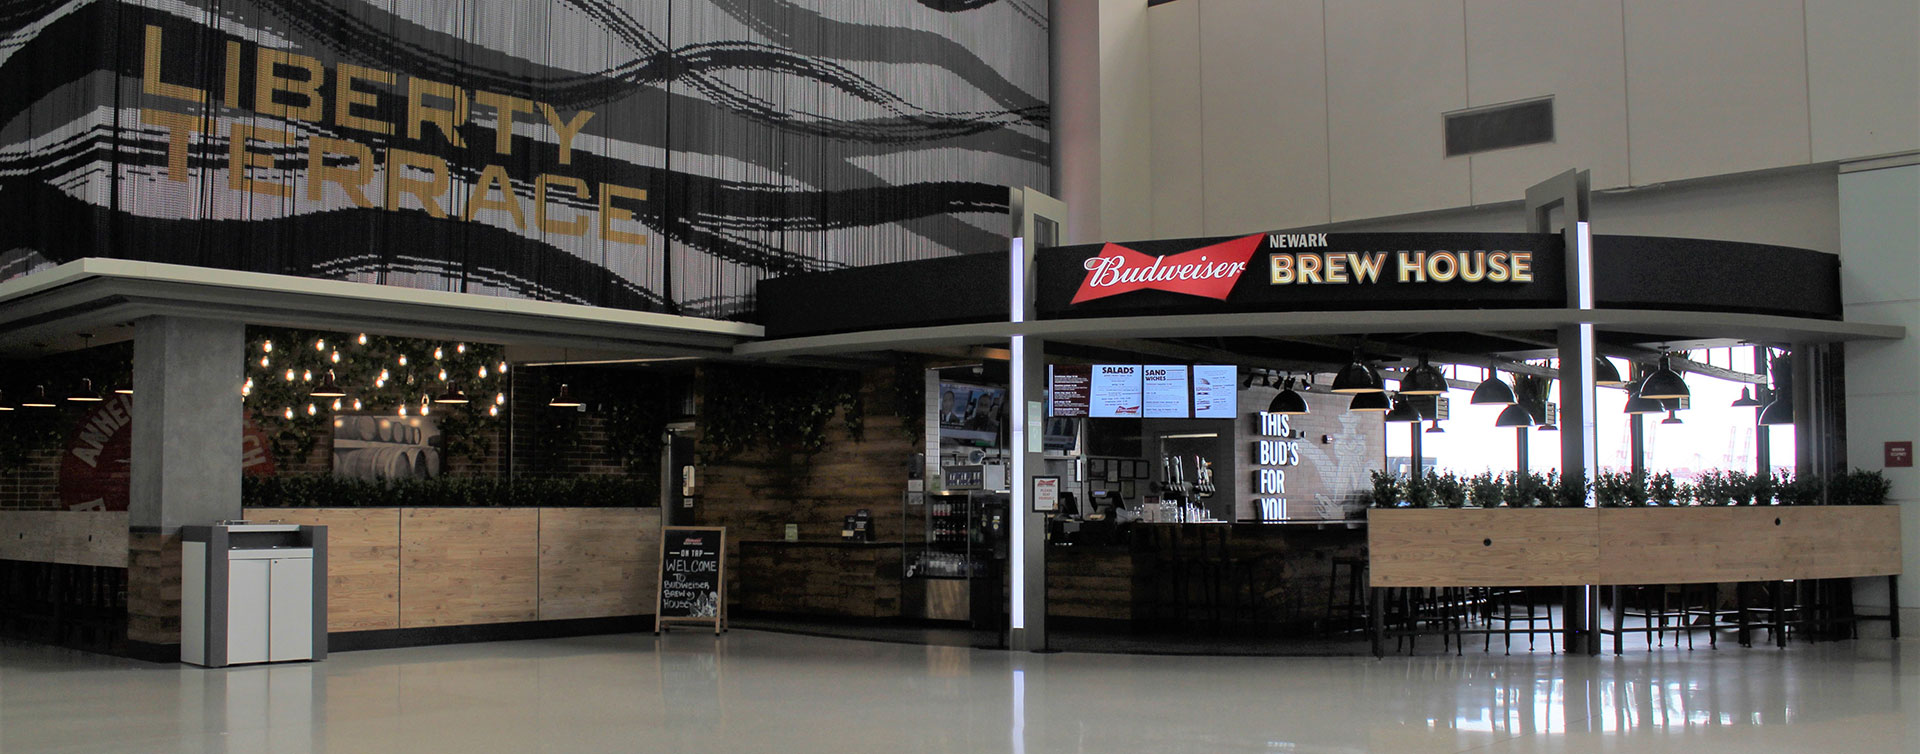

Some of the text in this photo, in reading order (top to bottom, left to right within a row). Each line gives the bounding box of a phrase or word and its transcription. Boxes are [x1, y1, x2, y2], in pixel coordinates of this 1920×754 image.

[142, 23, 596, 164] LIBERTY
[140, 107, 648, 246] TERRACE
[1269, 233, 1328, 248] NEWARK
[1084, 254, 1246, 287] Budweiser
[1269, 249, 1534, 284] BREW HOUSE
[1102, 366, 1134, 374] SALADS
[1260, 411, 1290, 437] THIS
[1260, 440, 1299, 466] BUD'S
[1260, 469, 1285, 495] FOR
[666, 559, 717, 573] WELCOME
[691, 549, 703, 557] TAP
[673, 573, 686, 582] TO
